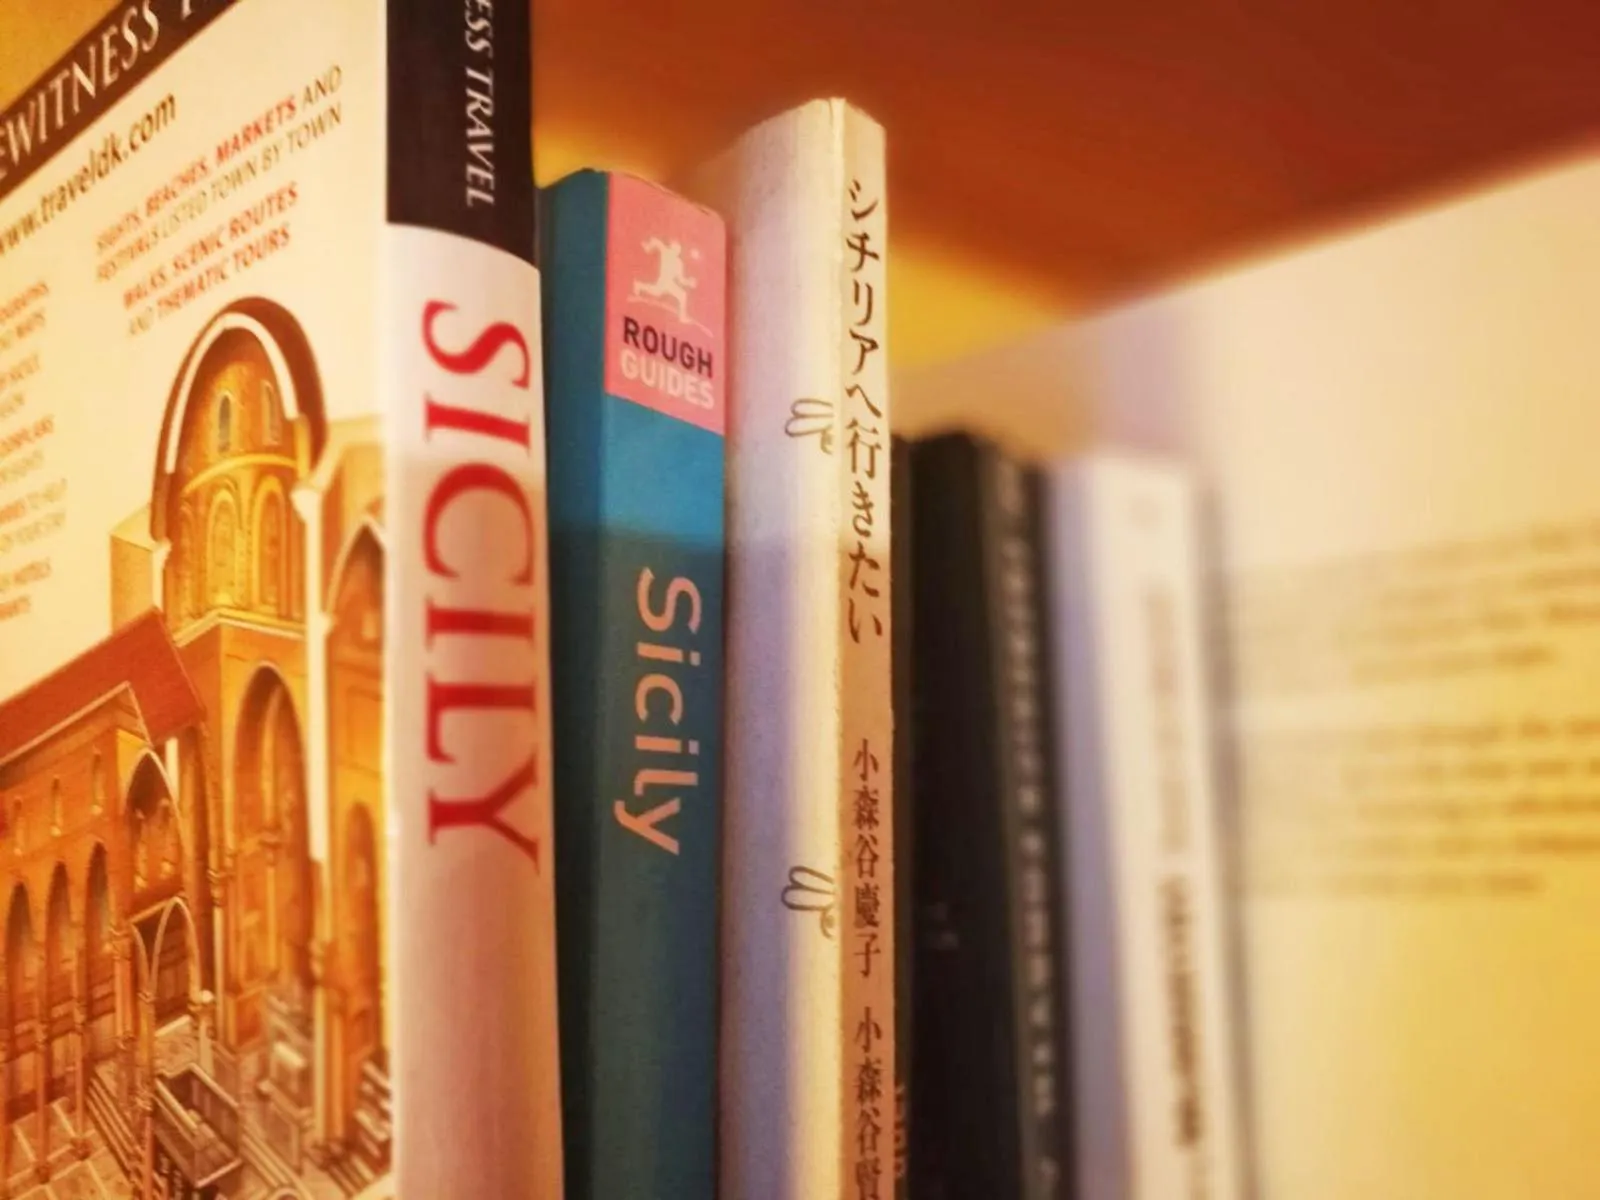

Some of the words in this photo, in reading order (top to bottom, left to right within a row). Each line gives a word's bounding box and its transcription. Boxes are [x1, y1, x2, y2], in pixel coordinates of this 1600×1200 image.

[211, 155, 258, 202] TOWN
[261, 139, 283, 172] BY
[286, 100, 342, 154] TOWN
[215, 94, 296, 167] MARKETS
[302, 63, 342, 111] AND
[465, 67, 495, 207] TRAVEL
[229, 180, 298, 241] ROUTES
[234, 221, 291, 273] TOURS
[620, 348, 715, 411] GUIDES
[623, 316, 713, 379] ROUGH
[845, 179, 882, 645] シチリアへ行きたい
[421, 298, 541, 875] SICILY
[614, 567, 702, 856] Sicily
